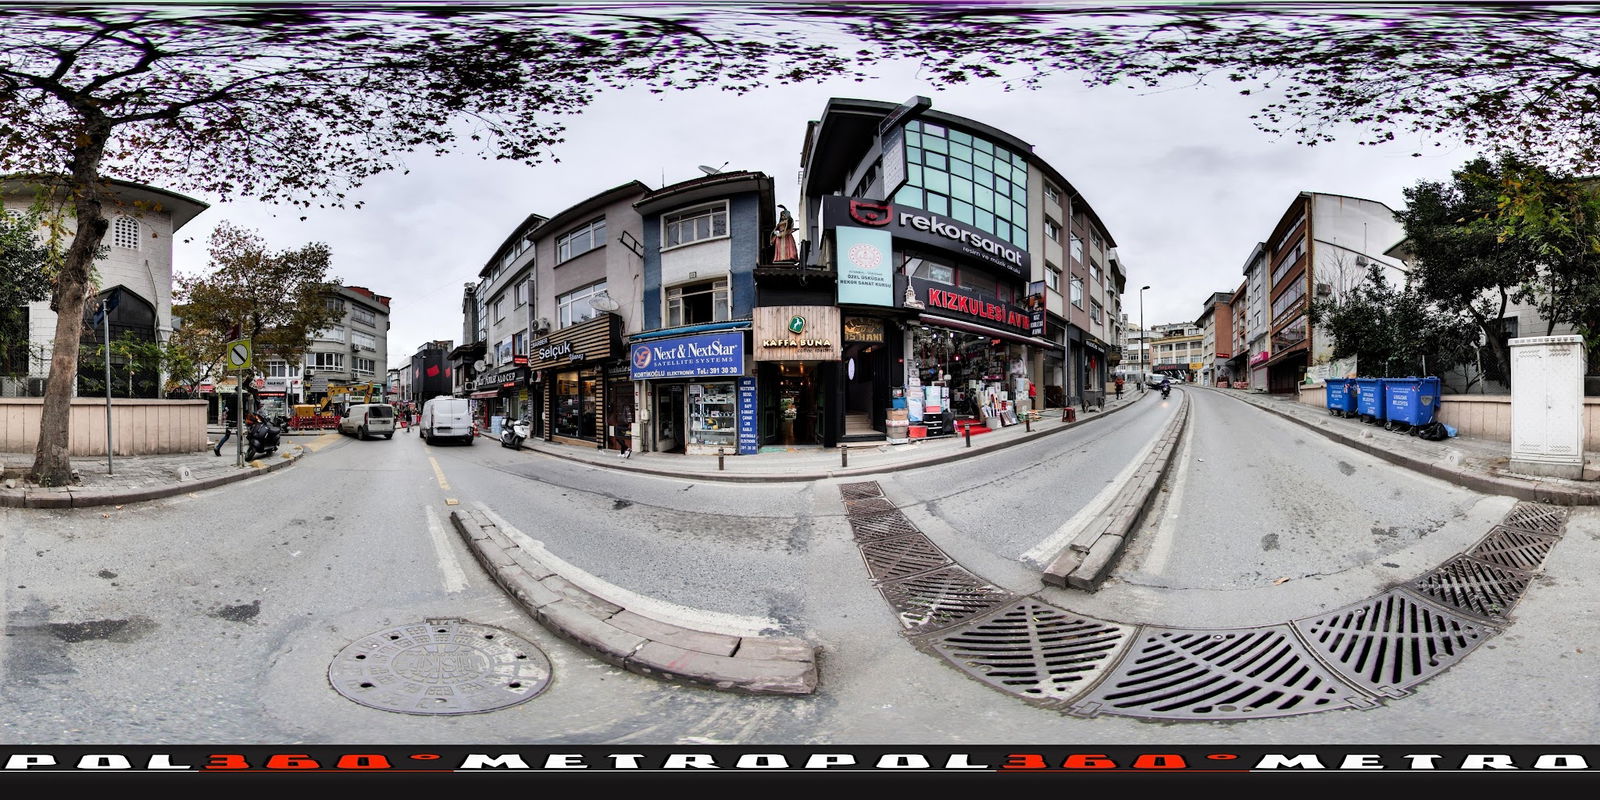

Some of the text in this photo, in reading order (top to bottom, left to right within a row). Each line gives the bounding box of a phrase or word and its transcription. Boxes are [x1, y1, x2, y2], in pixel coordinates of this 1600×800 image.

[900, 213, 1022, 266] rekorsanat
[962, 246, 980, 256] resim
[538, 340, 571, 360] Selçuk
[654, 340, 737, 360] Next & NextStar
[763, 338, 832, 348] KAFFA BUNA
